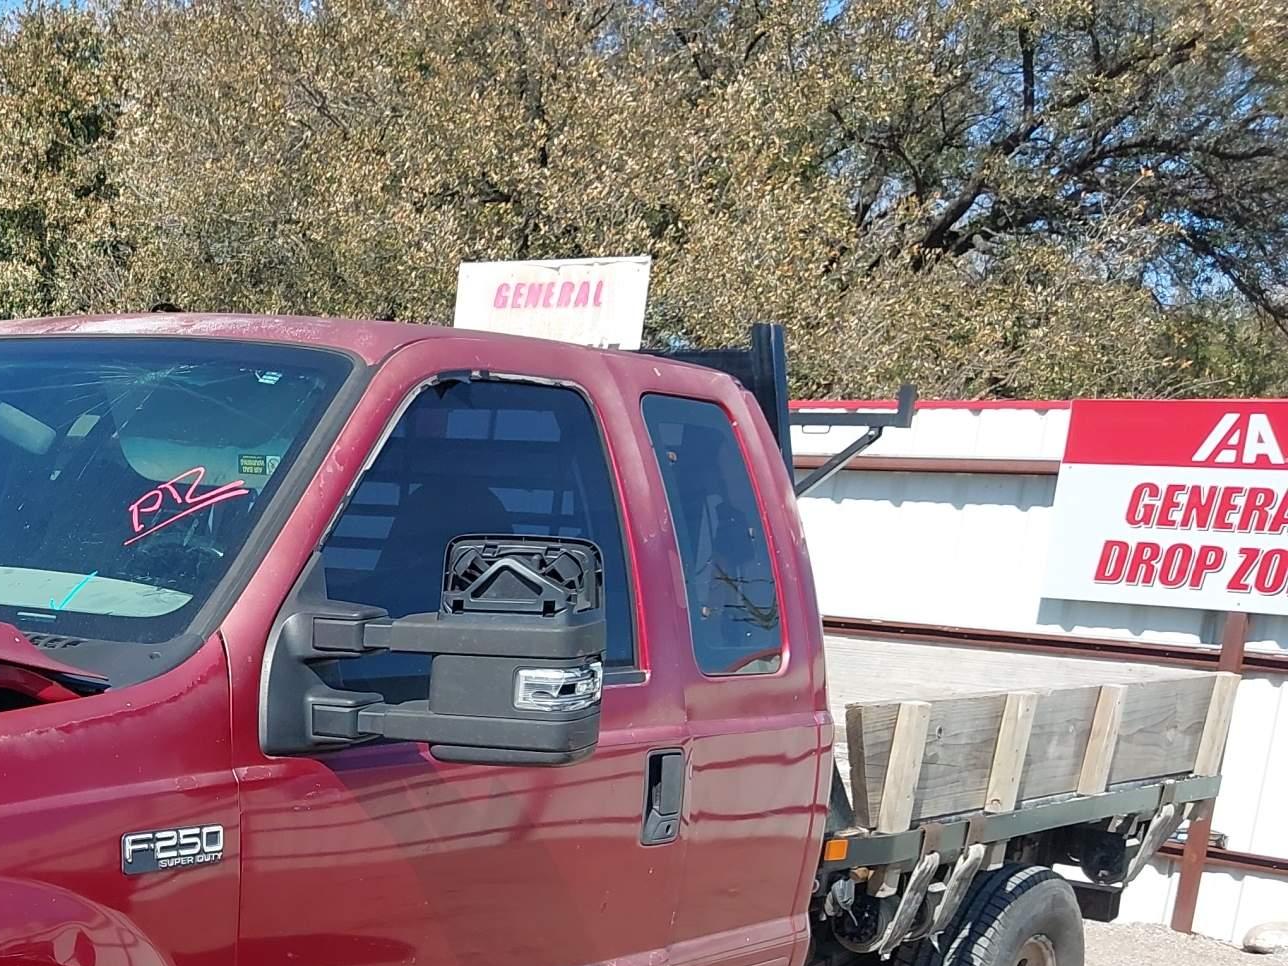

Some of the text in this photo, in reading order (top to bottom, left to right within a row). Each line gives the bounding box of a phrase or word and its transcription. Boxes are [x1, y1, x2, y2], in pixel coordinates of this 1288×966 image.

[493, 280, 604, 309] GENERAL
[1092, 540, 1288, 596] DROP ZO
[159, 852, 223, 868] SUPER DUTY
